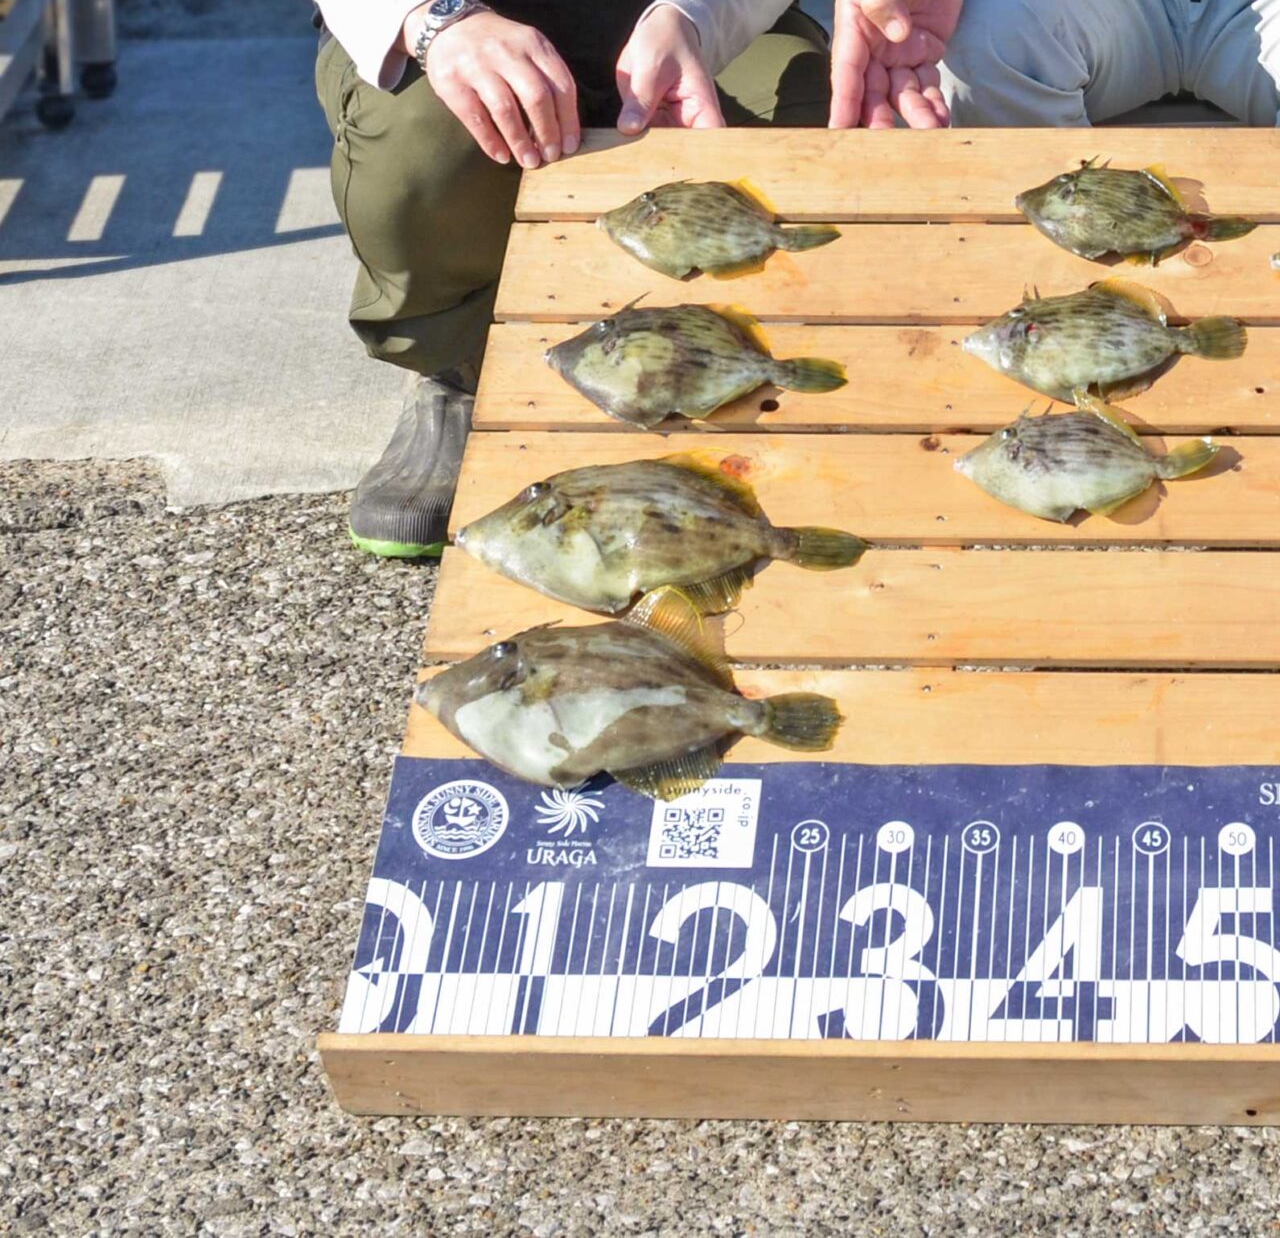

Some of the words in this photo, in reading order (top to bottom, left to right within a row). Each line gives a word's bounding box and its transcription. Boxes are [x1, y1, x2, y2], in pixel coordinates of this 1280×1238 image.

[800, 828, 820, 844] 25
[886, 830, 906, 845] 30
[970, 829, 991, 846] 35
[1057, 831, 1077, 846] 40
[1141, 830, 1162, 847] 45
[1228, 831, 1247, 847] 50
[526, 847, 598, 869] URAGA
[510, 881, 565, 1035] 1
[647, 881, 777, 1037] 2
[817, 882, 945, 1041] 3
[988, 886, 1117, 1042] 4
